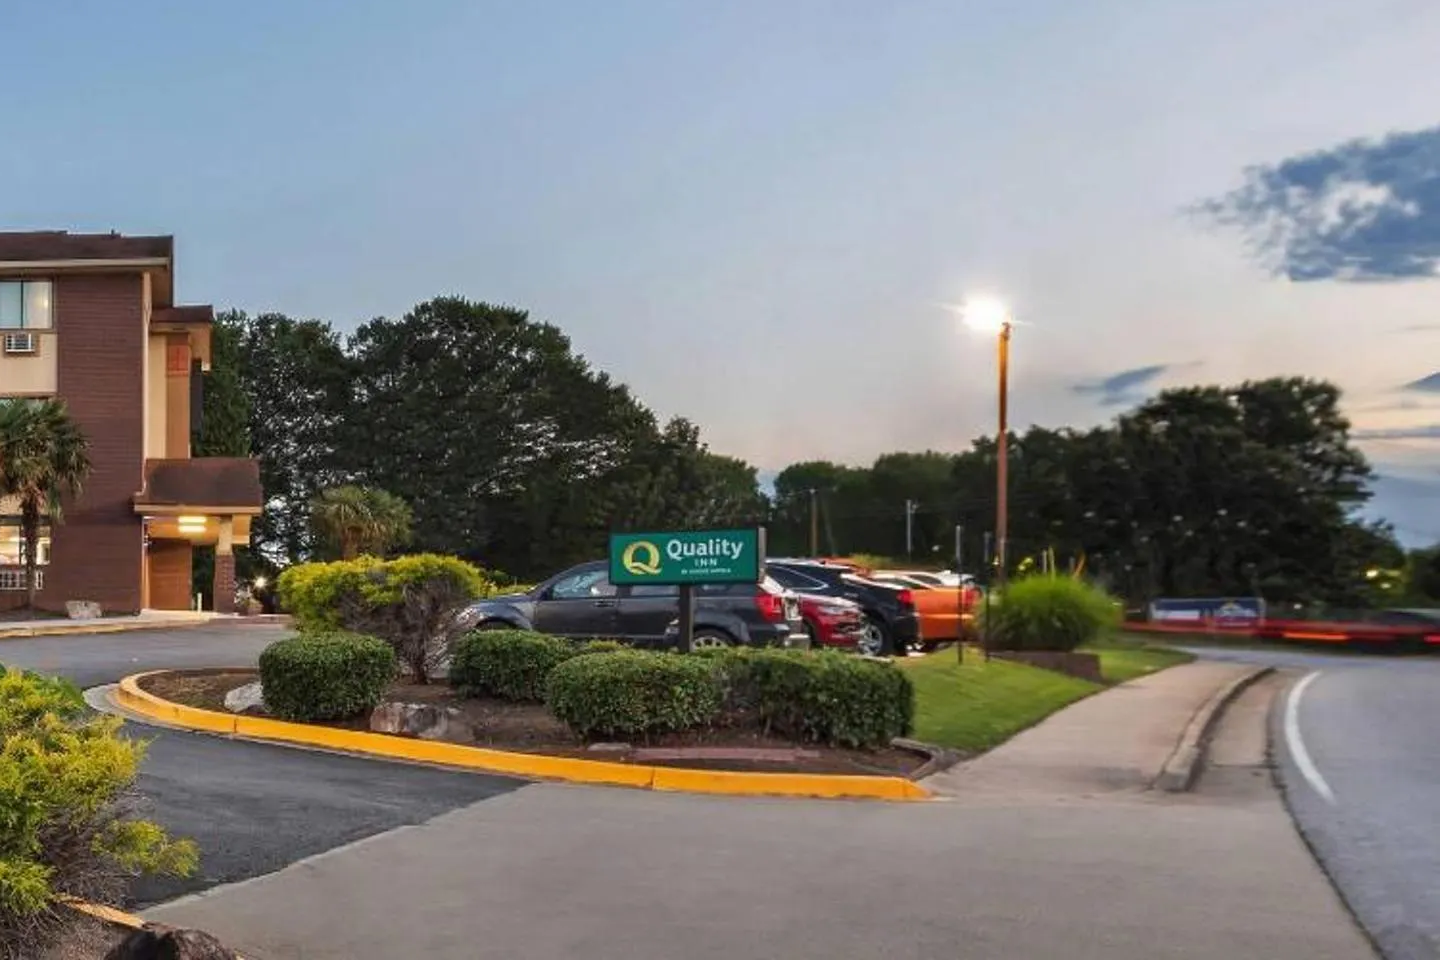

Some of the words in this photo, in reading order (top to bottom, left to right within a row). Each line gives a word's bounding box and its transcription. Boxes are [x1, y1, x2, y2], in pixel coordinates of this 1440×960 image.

[622, 540, 661, 575] Q
[666, 539, 743, 560] Quality
[694, 558, 718, 567] INN
